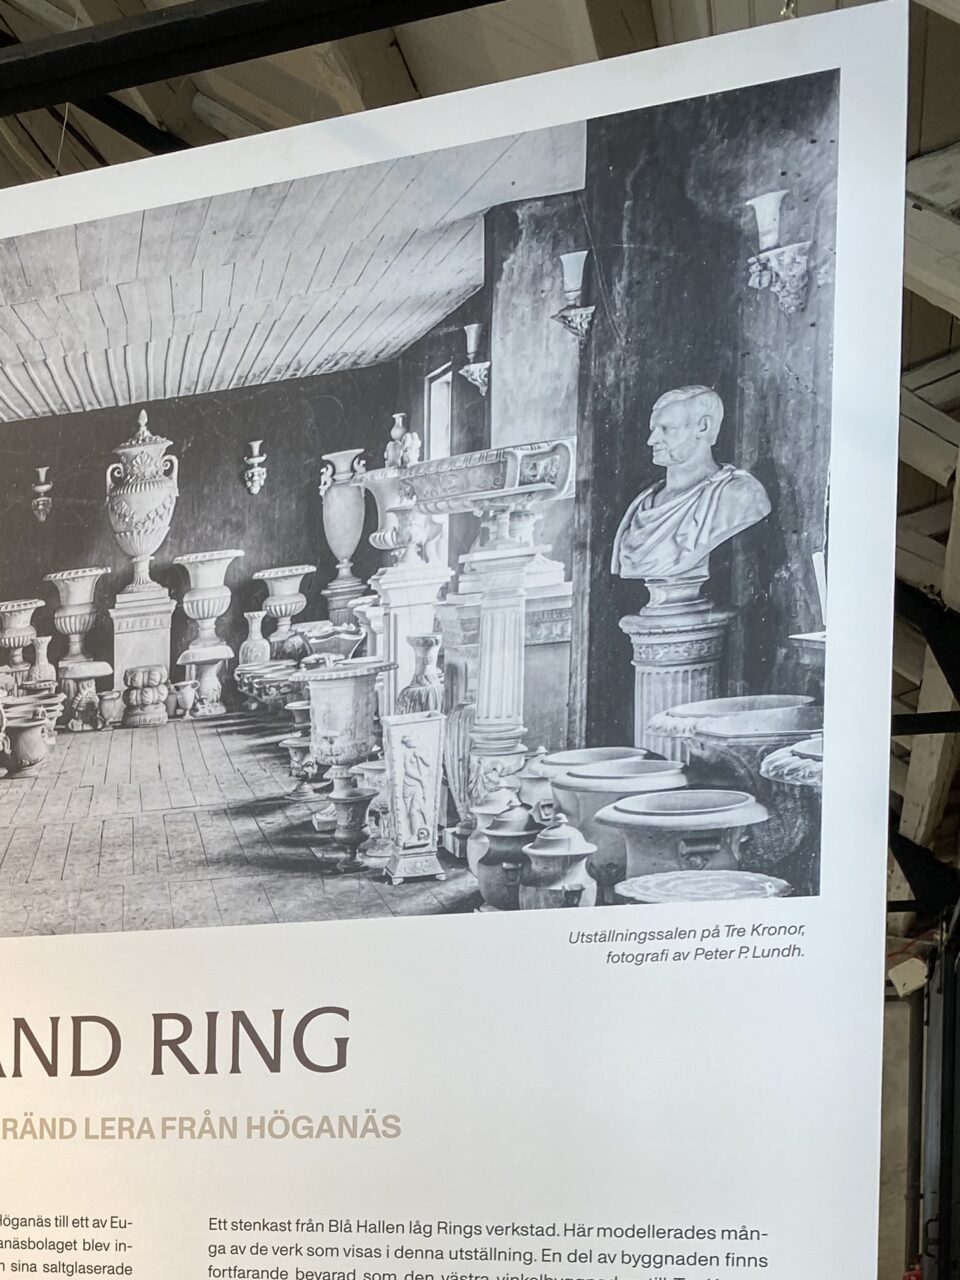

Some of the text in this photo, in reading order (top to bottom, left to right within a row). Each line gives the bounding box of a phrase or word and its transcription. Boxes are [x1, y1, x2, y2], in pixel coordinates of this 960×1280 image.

[568, 922, 806, 945] Utställningssalen på Tre Kronor,
[606, 948, 670, 966] fotografi
[671, 950, 691, 962] av
[693, 946, 736, 961] Peter
[149, 1005, 350, 1076] RING
[83, 1115, 157, 1141] LERA
[160, 1107, 238, 1140] FRÅN
[245, 1107, 402, 1140] HÖGANÄS
[81, 1237, 111, 1252] blev
[114, 1238, 133, 1253] in-
[206, 1263, 289, 1280] fortfarande
